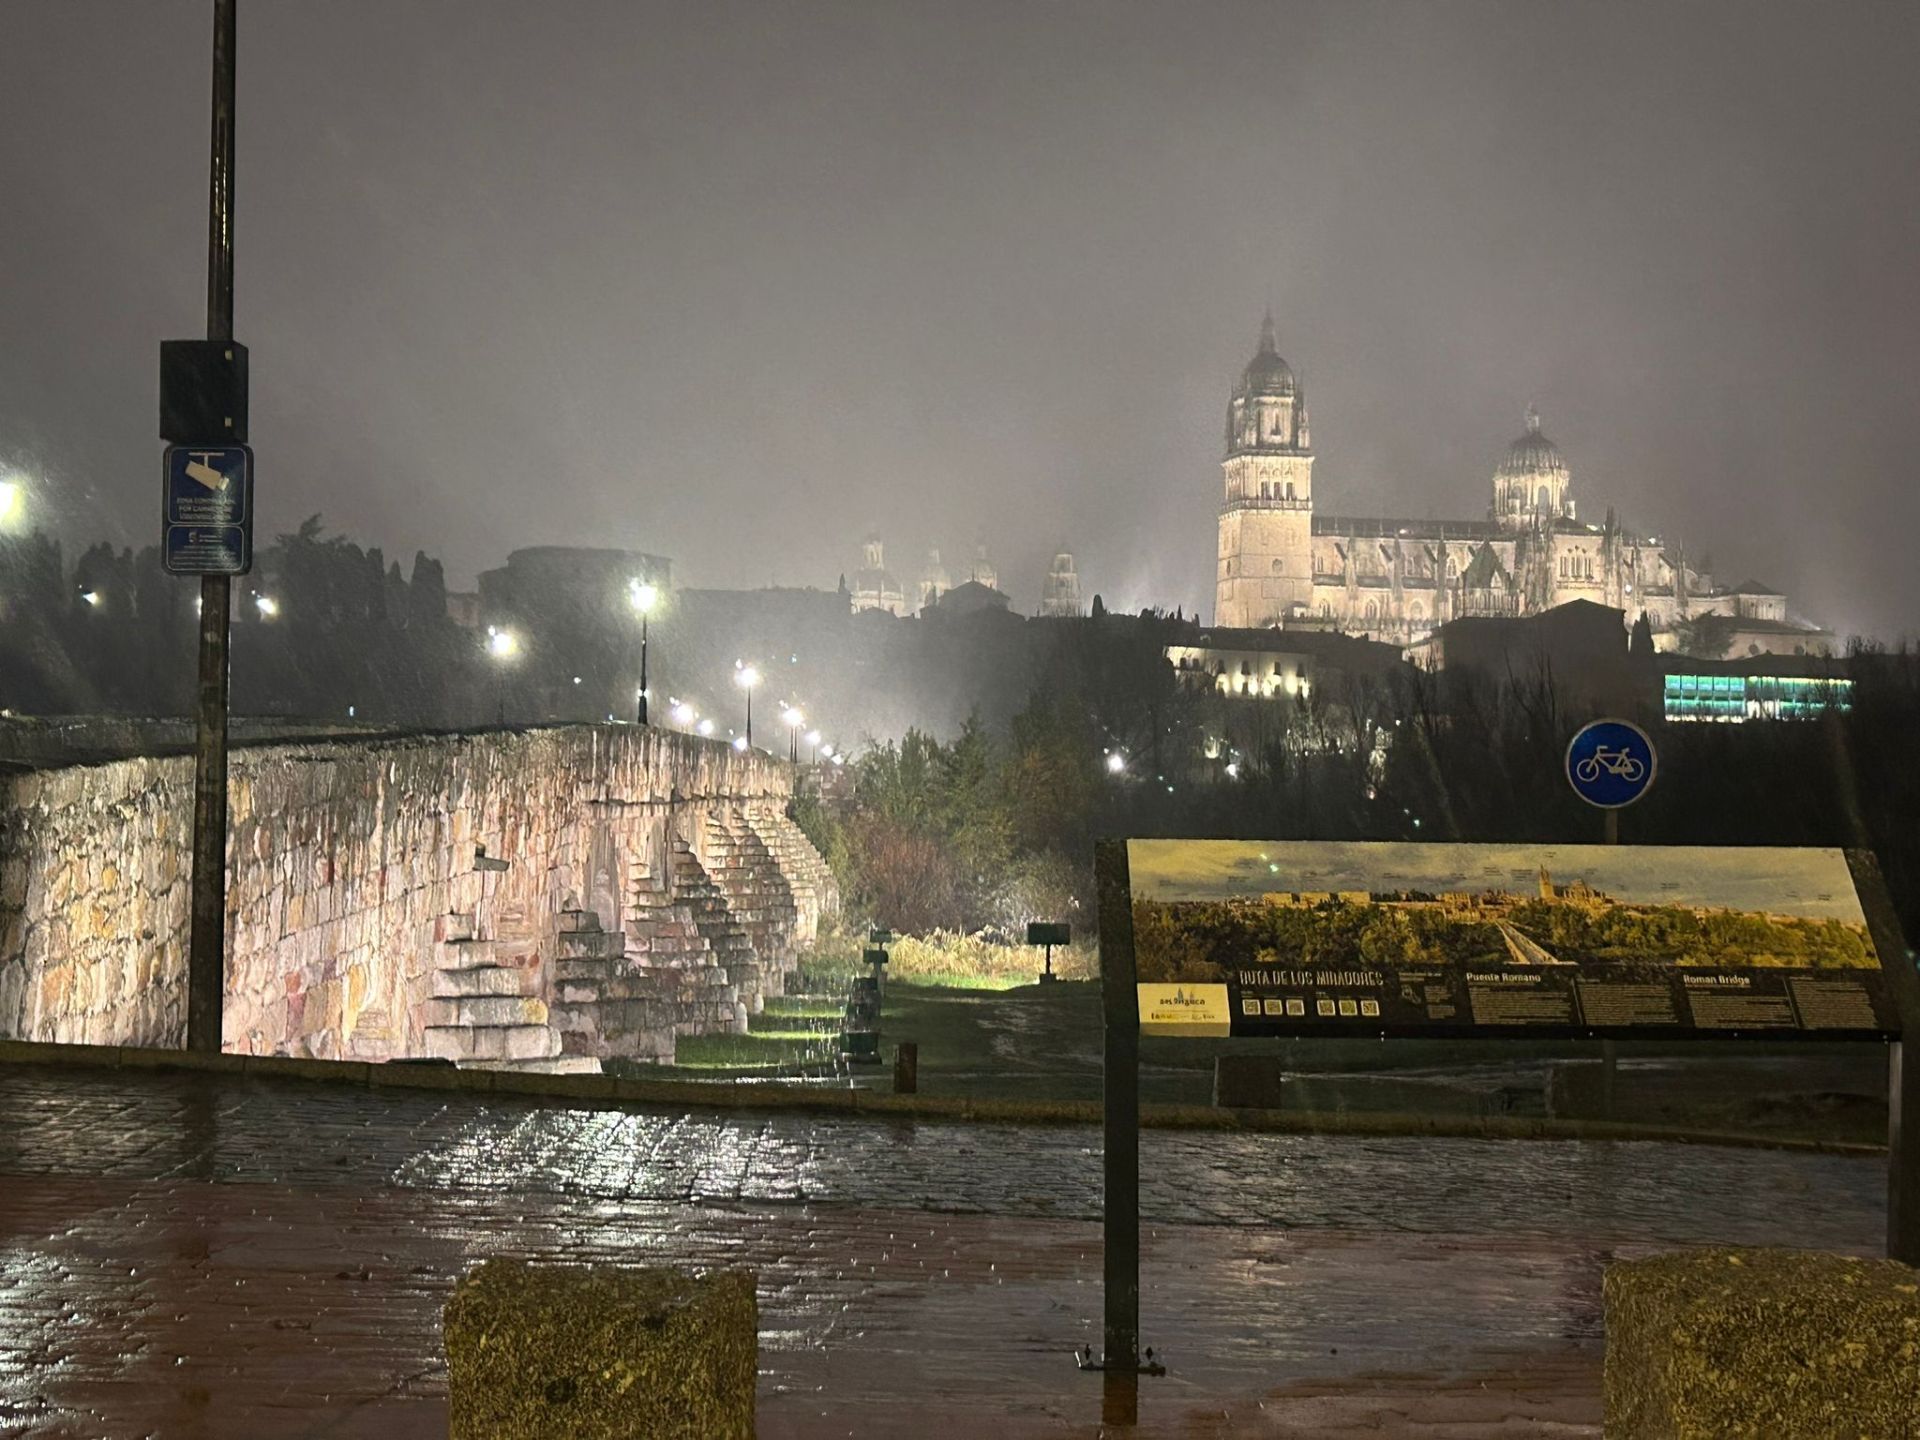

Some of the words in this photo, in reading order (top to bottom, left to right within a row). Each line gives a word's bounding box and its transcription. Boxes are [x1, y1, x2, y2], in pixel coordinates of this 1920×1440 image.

[1240, 970, 1270, 985] RUTA
[1272, 970, 1288, 985] DE
[1290, 970, 1313, 986] LOS
[1316, 970, 1383, 986] MIRADORES
[1466, 972, 1500, 982] Puente
[1502, 973, 1541, 982] Romano
[1683, 974, 1717, 984] Roman
[1718, 975, 1751, 986] Bridge
